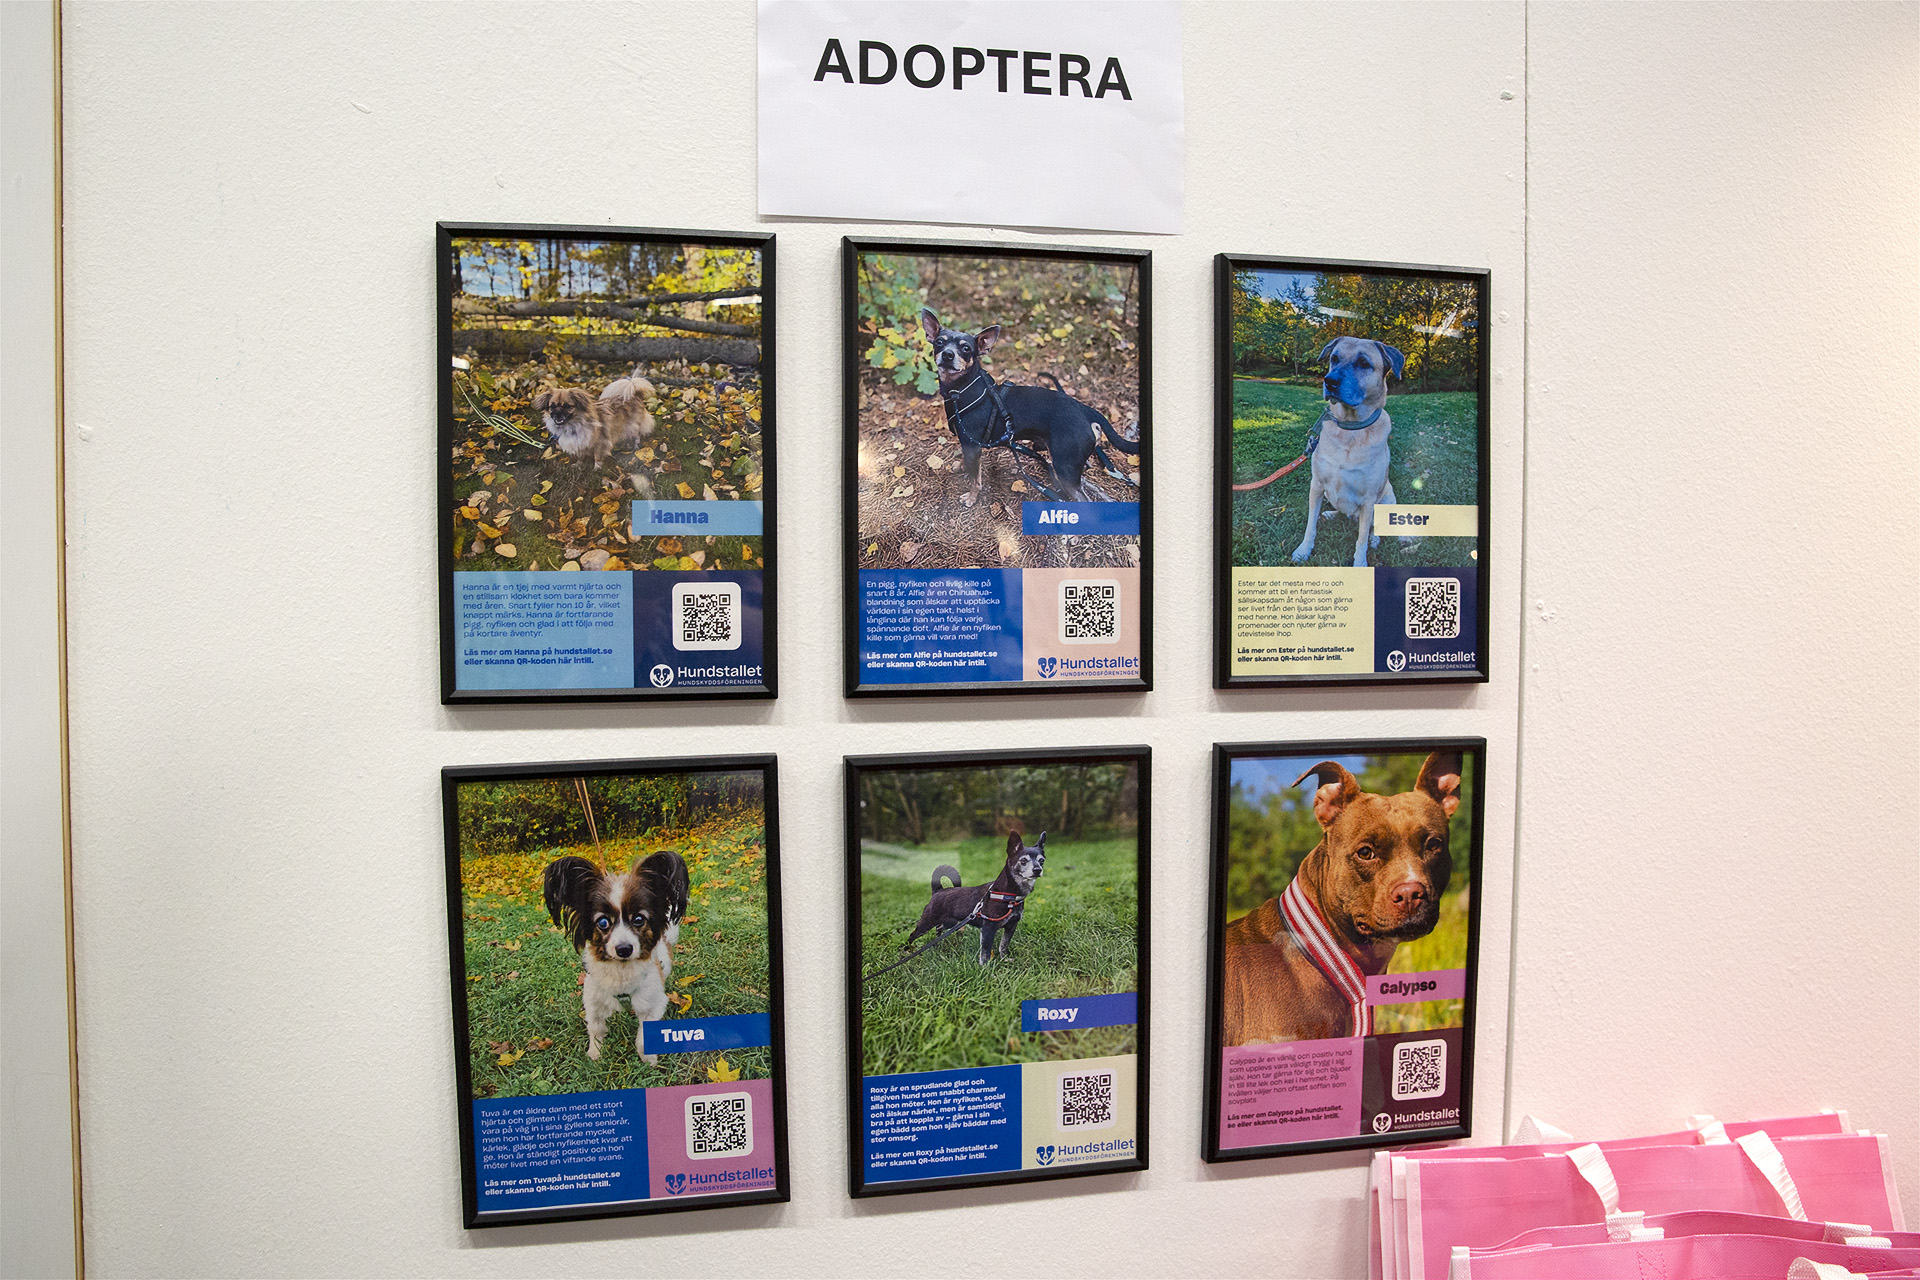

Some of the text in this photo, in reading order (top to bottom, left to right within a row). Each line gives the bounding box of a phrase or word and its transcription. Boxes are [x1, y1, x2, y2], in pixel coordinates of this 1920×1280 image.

[813, 38, 1132, 101] ADOPTERA
[650, 510, 708, 524] Hanna
[1039, 510, 1079, 524] Alfie
[1389, 513, 1429, 526] Ester
[866, 598, 905, 607] blandning
[463, 612, 493, 620] knappt
[867, 626, 910, 634] spännande
[542, 647, 552, 657] på
[933, 650, 942, 660] på
[1298, 646, 1306, 654] på
[1060, 656, 1138, 669] Hundstallet
[1409, 651, 1475, 663] Hundstallet
[678, 665, 762, 678] Hundstallet
[1380, 980, 1436, 996] Calypso
[1038, 1008, 1078, 1022] Roxy
[661, 1029, 704, 1042] Tuva
[911, 1082, 952, 1092] sprudlande
[966, 1086, 997, 1094] charmar
[1305, 1105, 1343, 1113] hundstallet.
[1394, 1108, 1459, 1123] Hundstallet
[537, 1130, 583, 1140] fortfarande
[586, 1128, 615, 1137] mycket
[946, 1144, 998, 1153] hundstallet.se
[1058, 1139, 1134, 1156] Hundstallet
[918, 1156, 953, 1165] QR-koden
[1058, 1152, 1135, 1163] HUNDSKYDDSFÖRENINGEN
[533, 1174, 562, 1183] Tuvapå
[564, 1171, 620, 1181] hundstallet.se
[690, 1167, 774, 1184] Hundstallet
[536, 1184, 574, 1193] QR-koden
[690, 1181, 774, 1192] HUNDSKYDDSFÖRENINGEN
